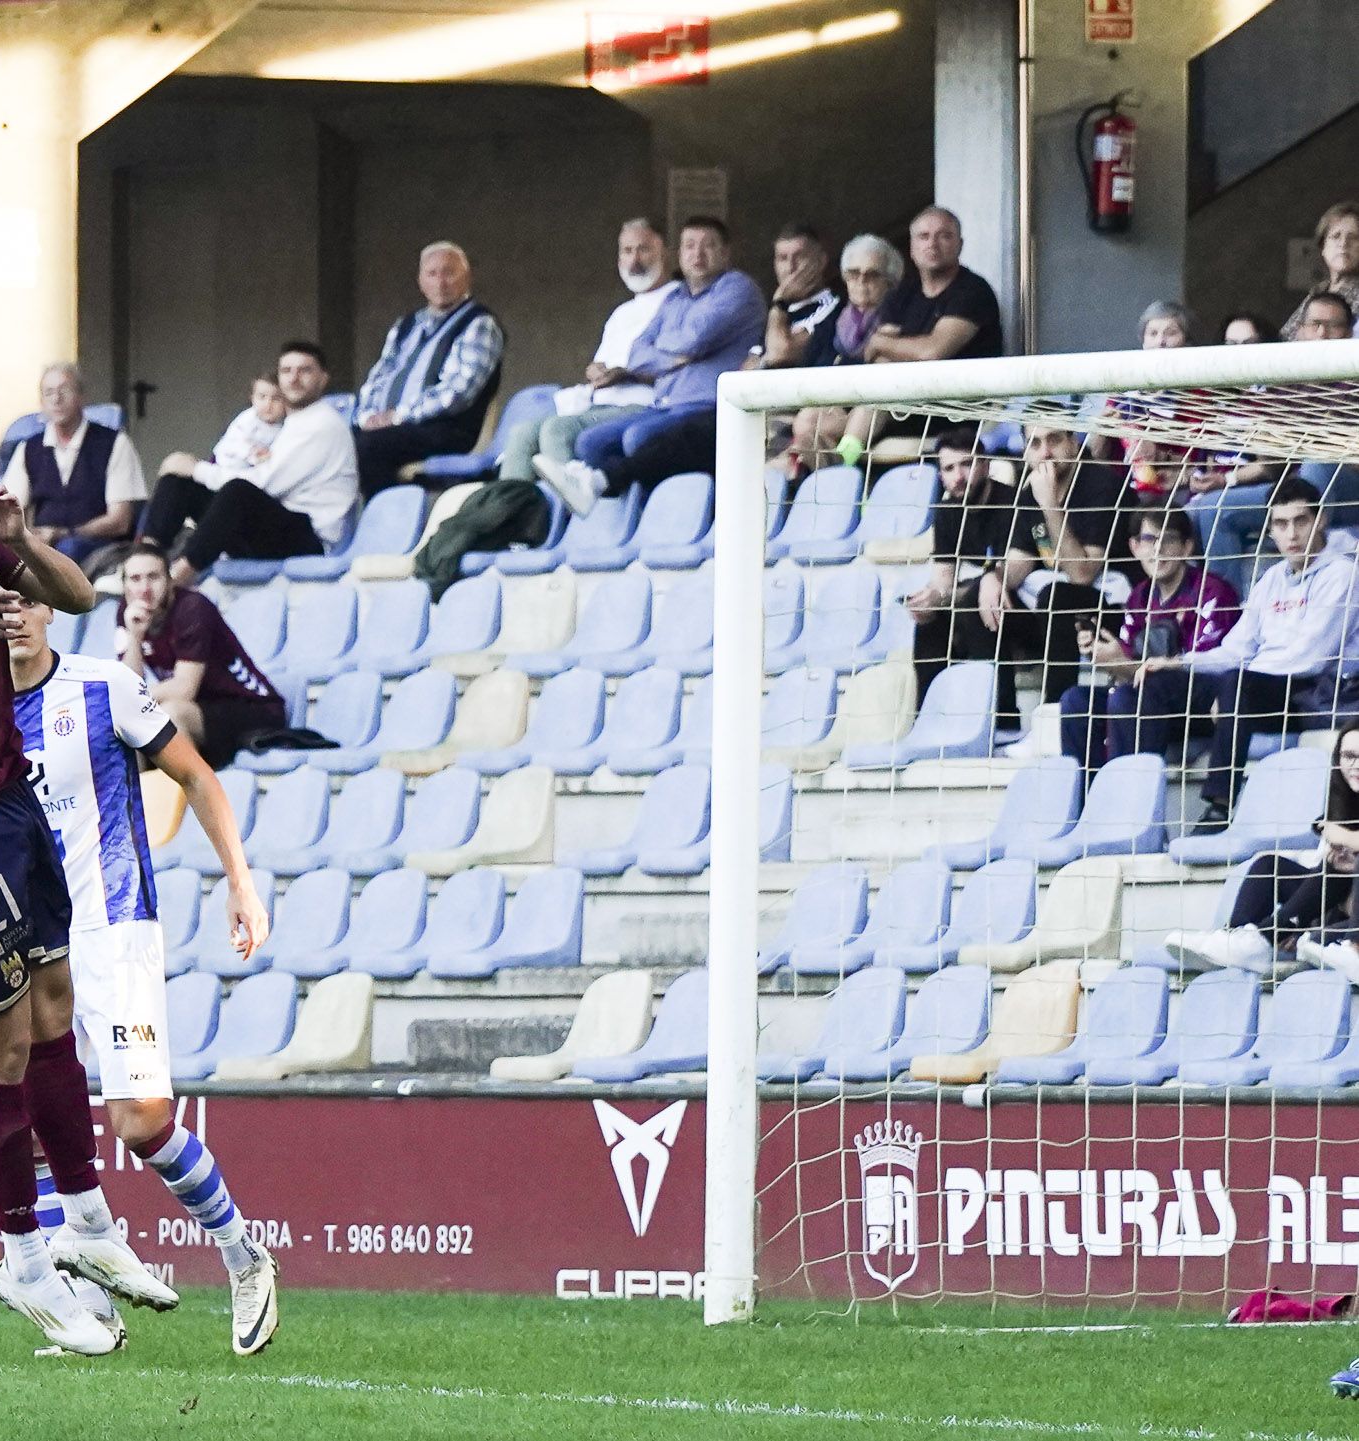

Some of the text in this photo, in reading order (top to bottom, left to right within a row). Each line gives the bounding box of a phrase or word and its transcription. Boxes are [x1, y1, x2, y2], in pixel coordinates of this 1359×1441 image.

[323, 1224, 342, 1253] T.
[347, 1225, 386, 1254] 986
[390, 1225, 431, 1254] 840
[435, 1225, 474, 1255] 892
[945, 1168, 1237, 1257] PINTURAS
